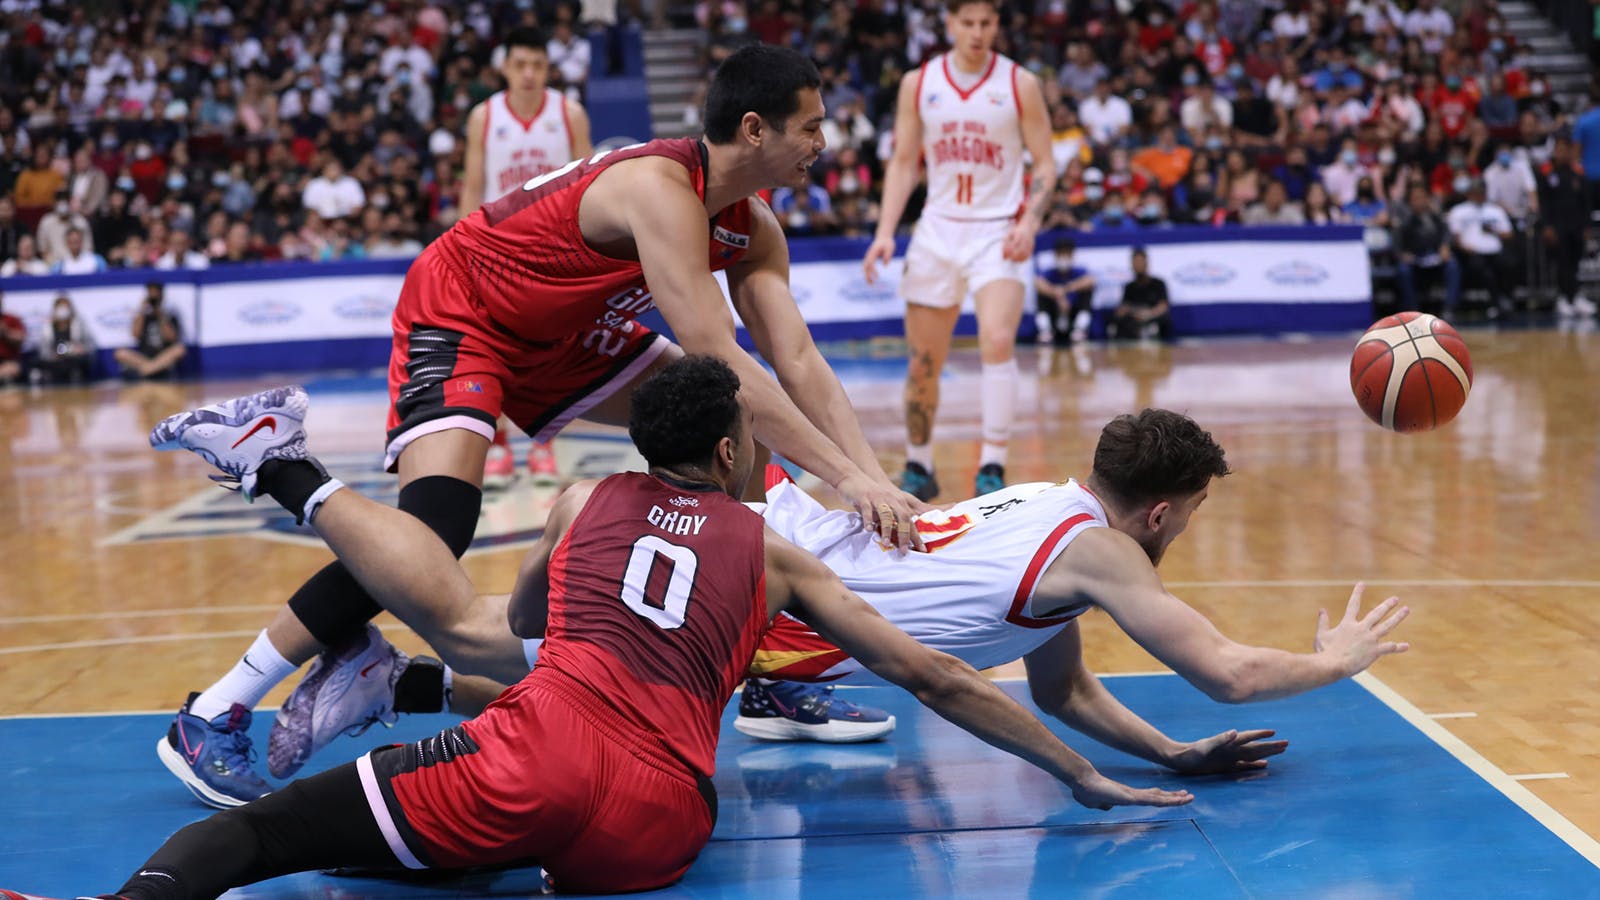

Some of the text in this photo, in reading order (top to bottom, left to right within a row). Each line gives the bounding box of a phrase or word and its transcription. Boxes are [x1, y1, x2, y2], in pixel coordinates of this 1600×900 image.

[933, 137, 1004, 171] DRAGONS
[956, 173, 973, 204] 11
[606, 287, 657, 314] GIN
[646, 504, 707, 536] GRAY
[619, 534, 699, 630] 0
